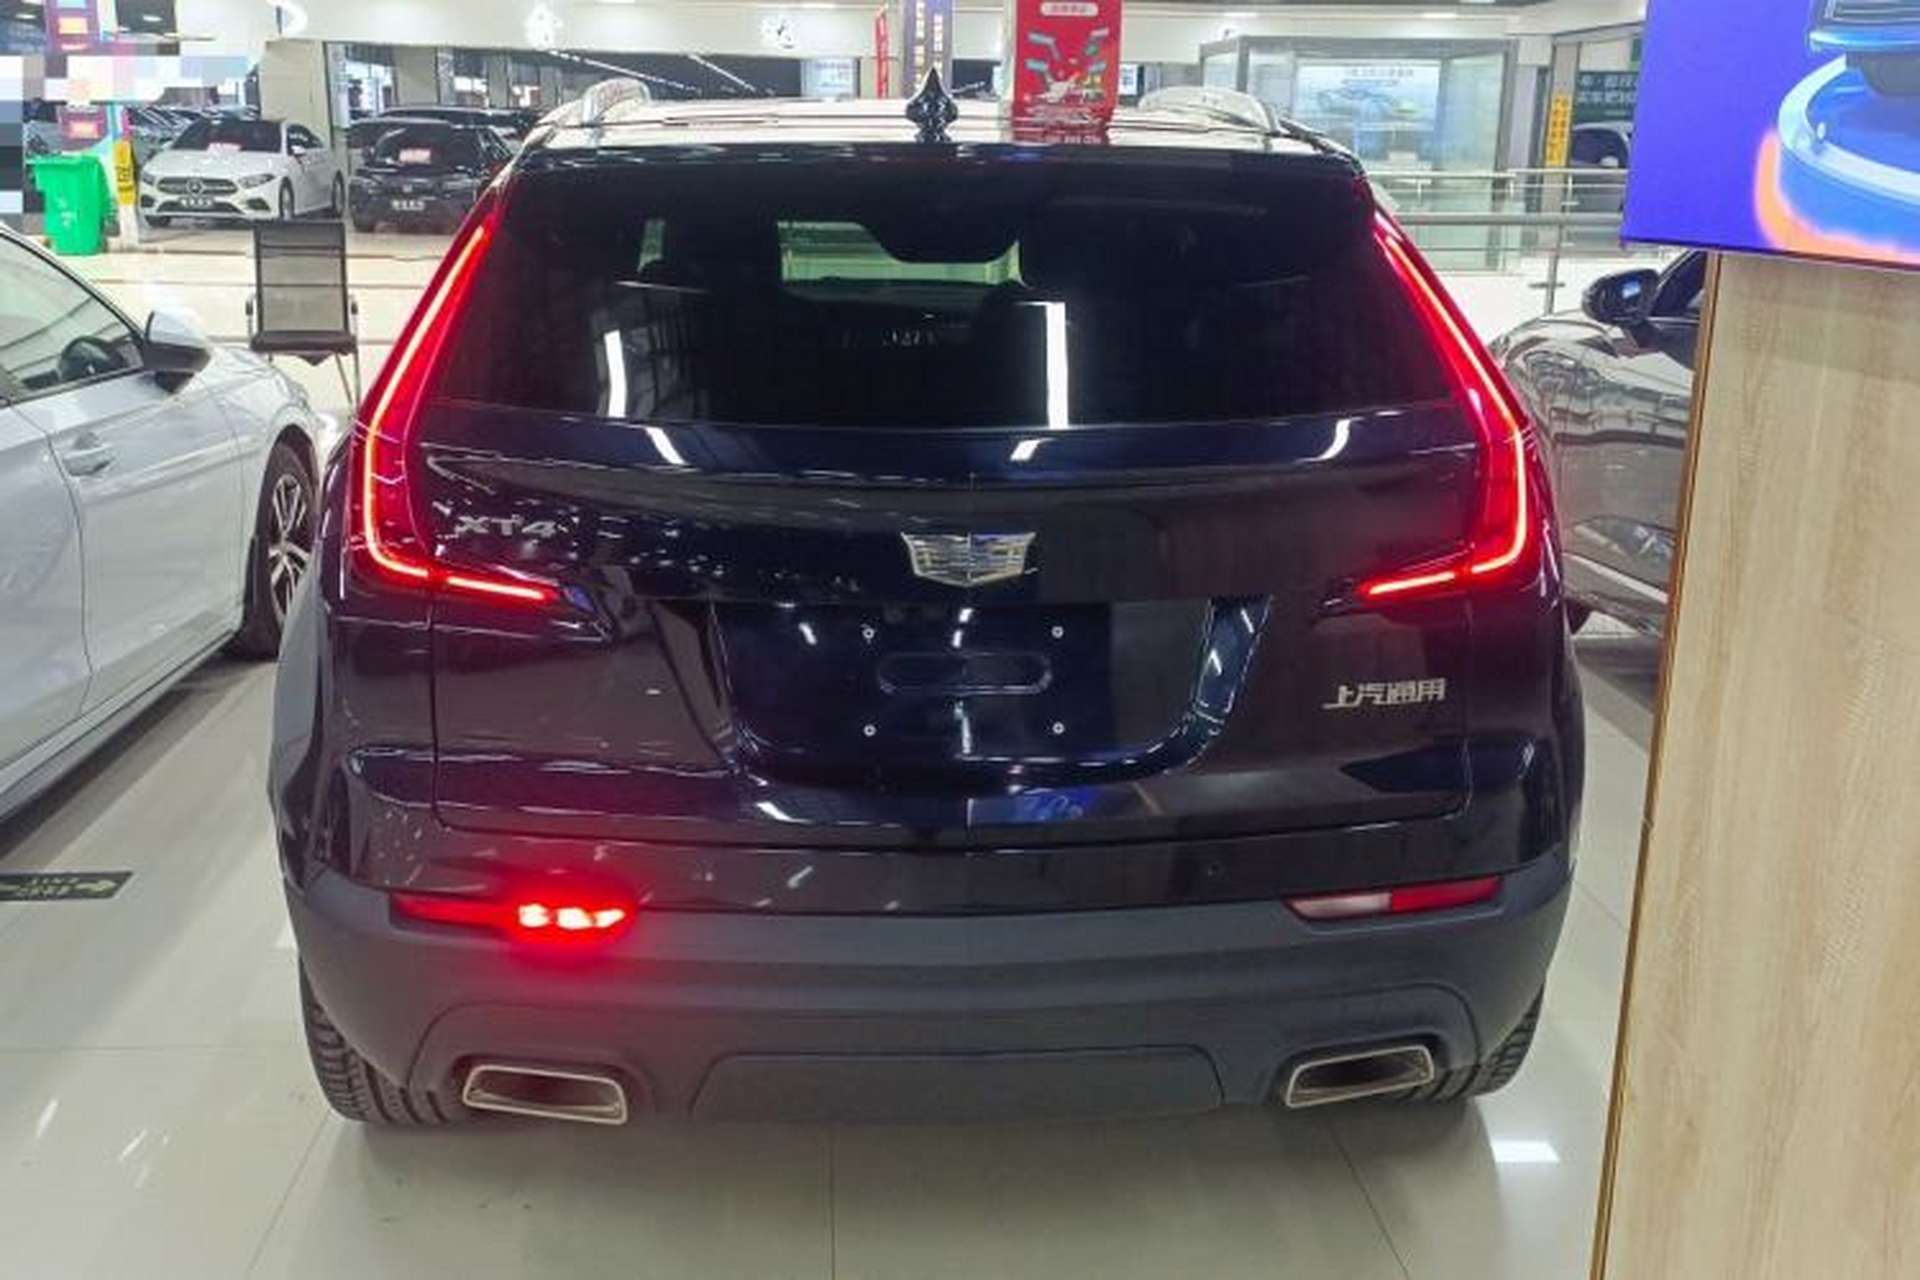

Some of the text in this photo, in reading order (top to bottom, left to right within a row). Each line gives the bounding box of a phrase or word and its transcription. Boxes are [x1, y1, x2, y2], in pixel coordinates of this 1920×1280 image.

[454, 515, 556, 538] XT4
[1322, 677, 1446, 709] 上汽通用
